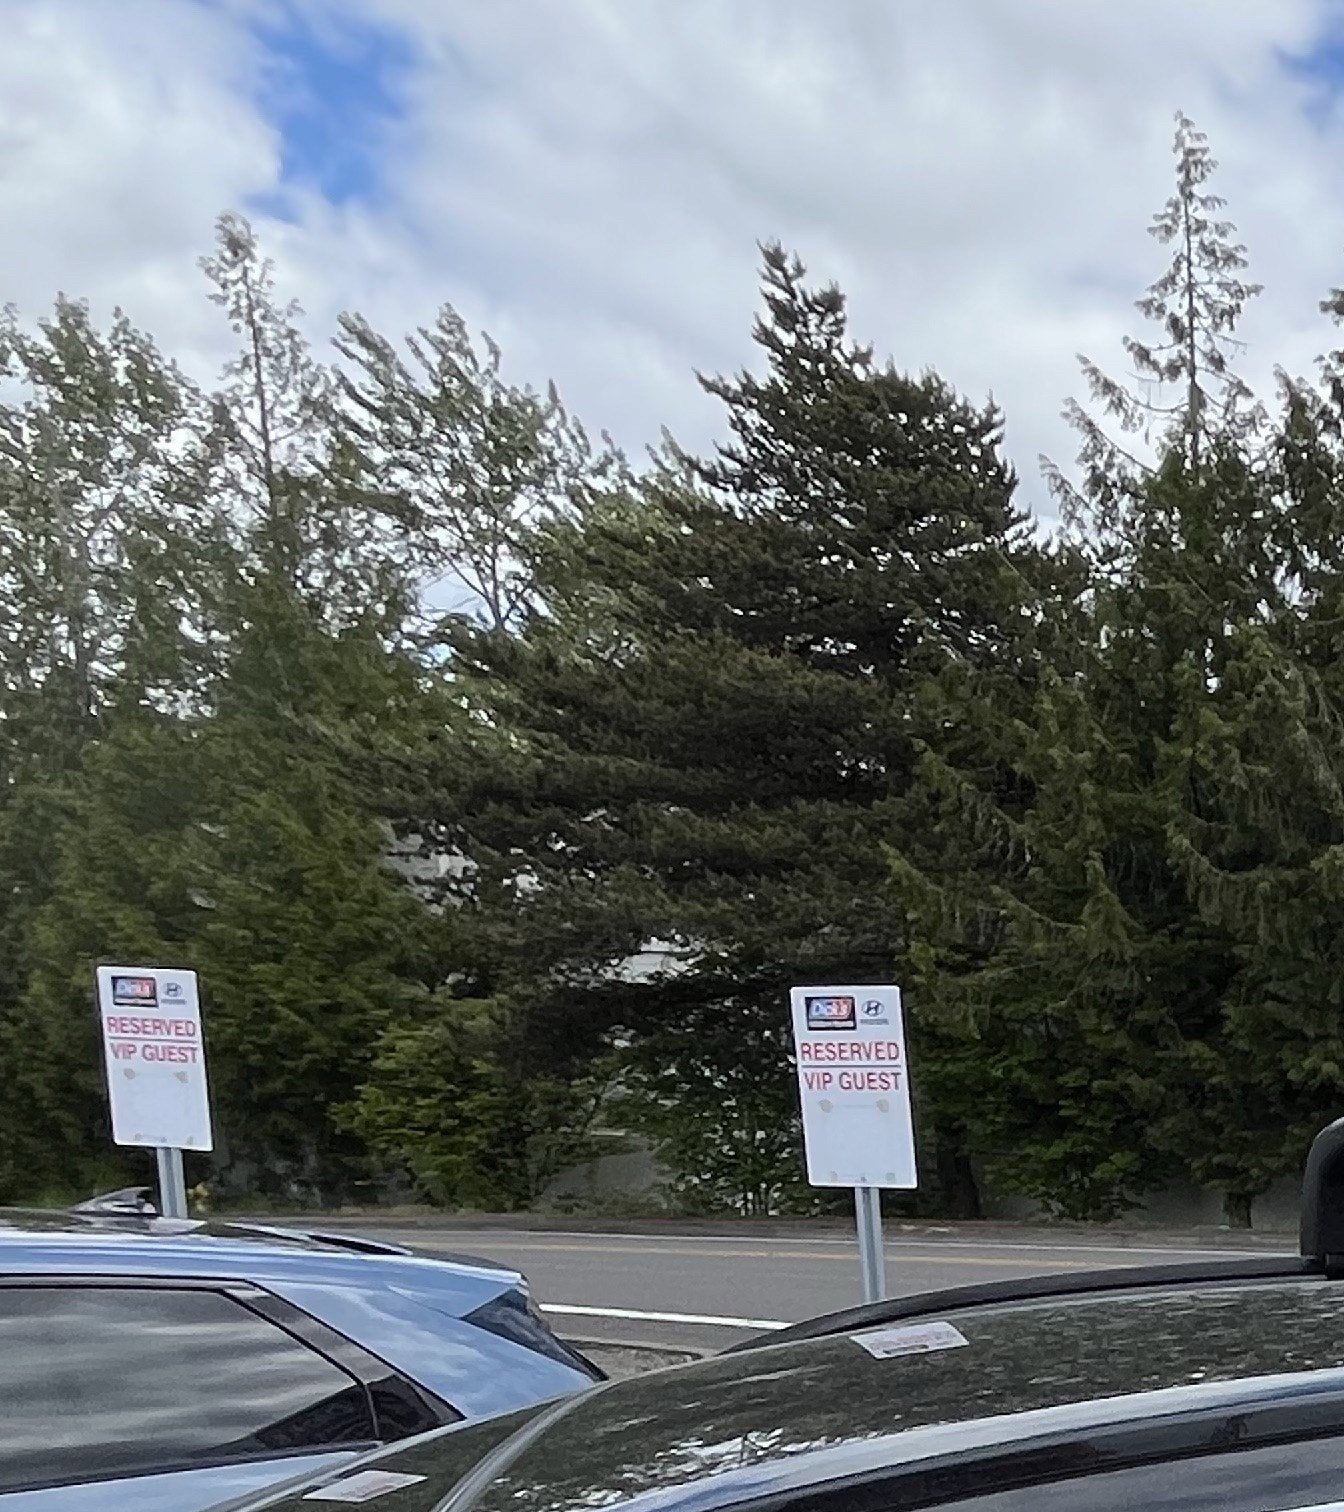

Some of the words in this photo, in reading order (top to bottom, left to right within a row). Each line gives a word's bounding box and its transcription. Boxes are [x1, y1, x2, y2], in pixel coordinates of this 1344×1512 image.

[106, 1015, 197, 1038] RESERVED
[111, 1042, 137, 1060] VIP
[141, 1044, 198, 1064] GUEST
[800, 1041, 901, 1062] RESERVED
[804, 1072, 833, 1091] VIP
[838, 1071, 902, 1091] GUEST
